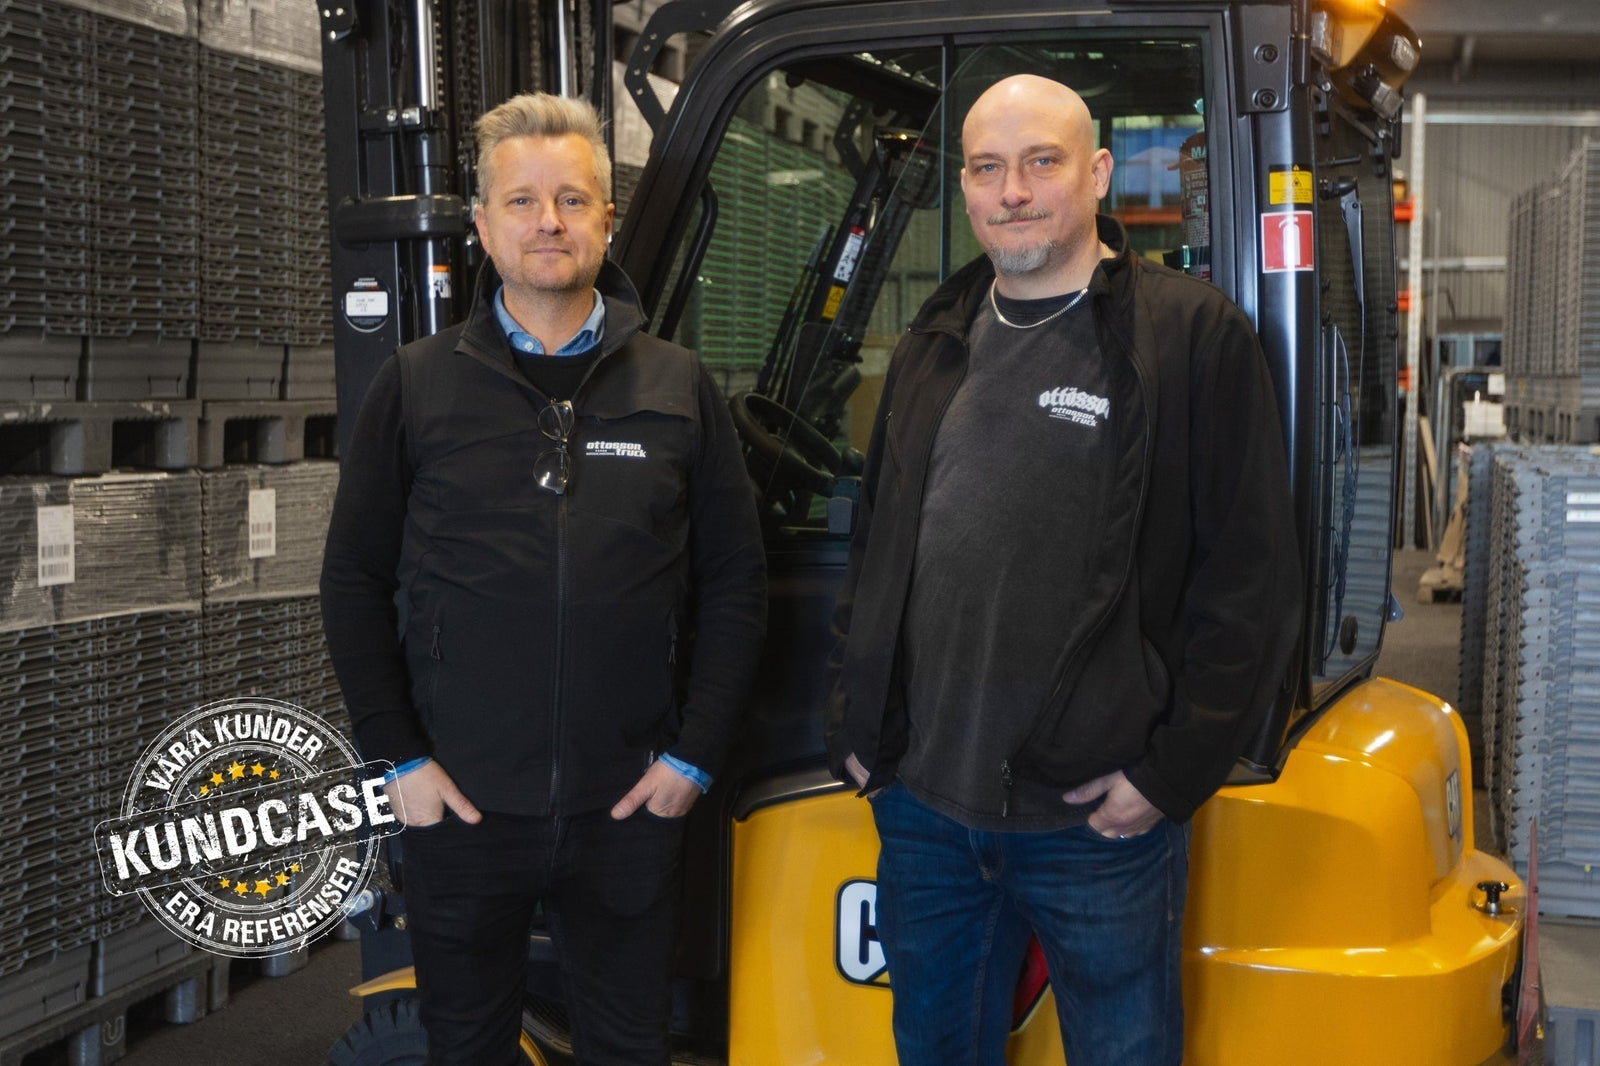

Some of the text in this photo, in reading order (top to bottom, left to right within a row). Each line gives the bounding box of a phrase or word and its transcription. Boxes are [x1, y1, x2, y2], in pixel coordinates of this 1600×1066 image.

[1071, 415, 1098, 427] truck
[586, 441, 642, 450] ottosson
[615, 448, 647, 458] truck
